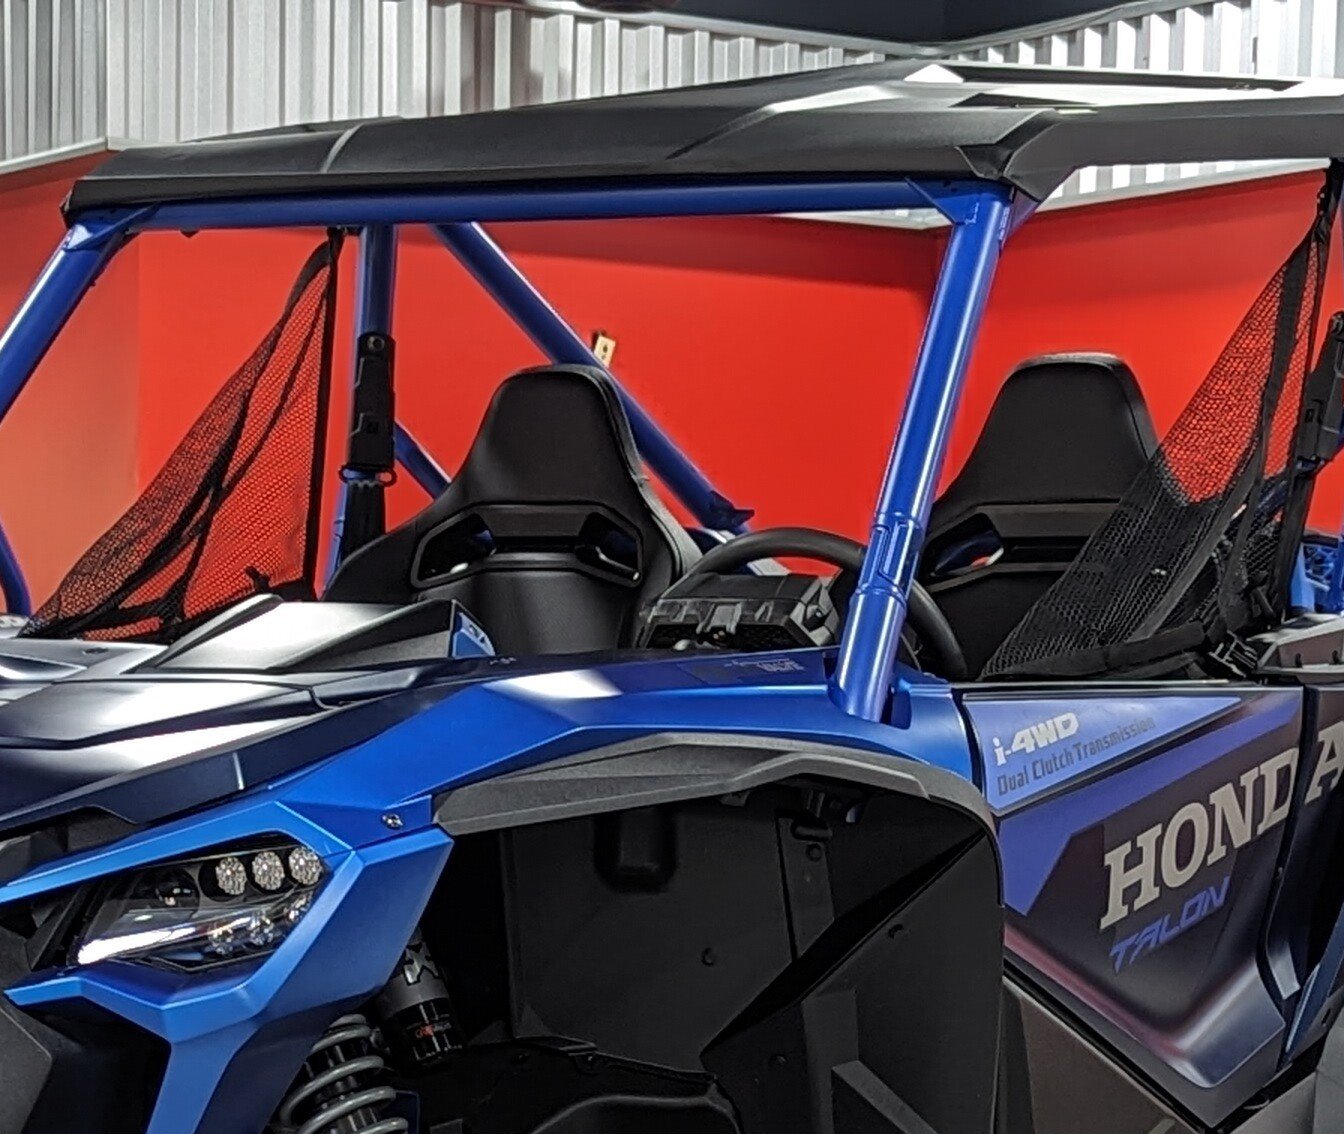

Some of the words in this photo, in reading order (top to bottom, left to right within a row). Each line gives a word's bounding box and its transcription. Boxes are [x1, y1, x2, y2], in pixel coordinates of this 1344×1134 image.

[993, 713, 1079, 766] i-4WD
[997, 765, 1030, 796] Dual
[1032, 750, 1075, 780] Clutch
[1073, 717, 1156, 762] Transmission
[1110, 875, 1231, 974] TALON
